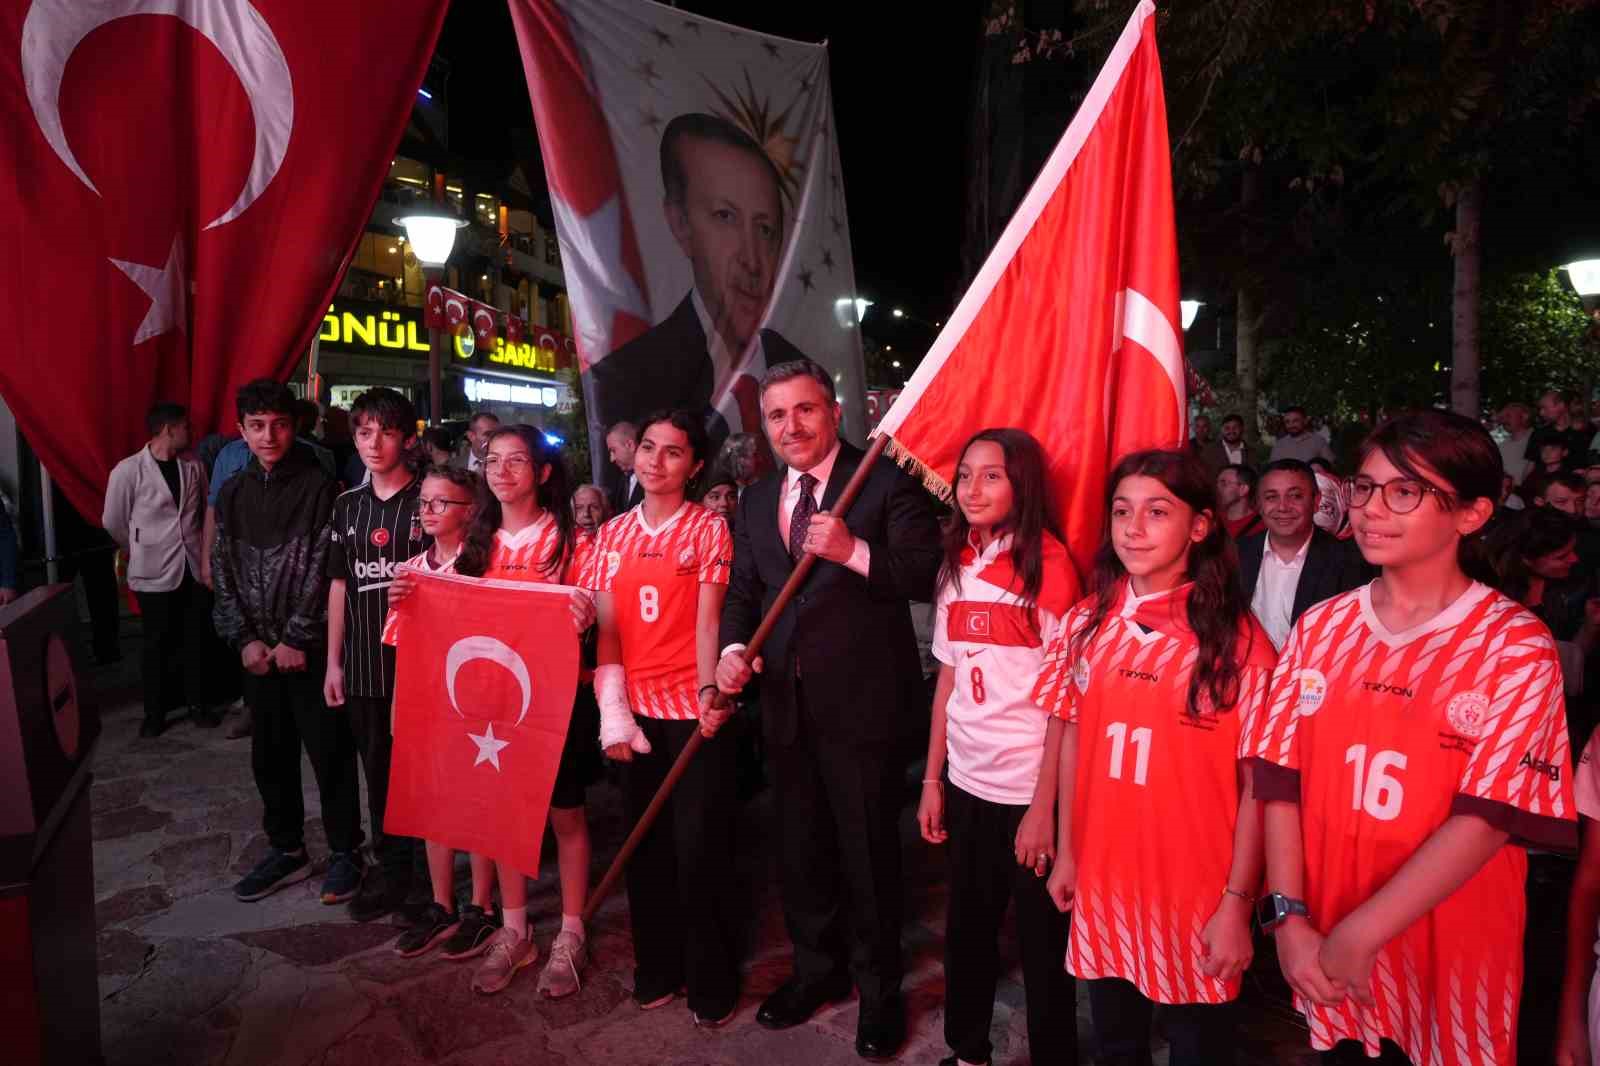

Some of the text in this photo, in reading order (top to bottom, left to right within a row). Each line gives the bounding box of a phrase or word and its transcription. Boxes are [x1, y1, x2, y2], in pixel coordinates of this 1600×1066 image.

[639, 585, 659, 623] 8
[970, 666, 985, 706] 8
[1119, 668, 1159, 682] TRYON
[1362, 681, 1413, 698] TRYON
[1106, 721, 1153, 786] 11
[1344, 743, 1408, 821] 16
